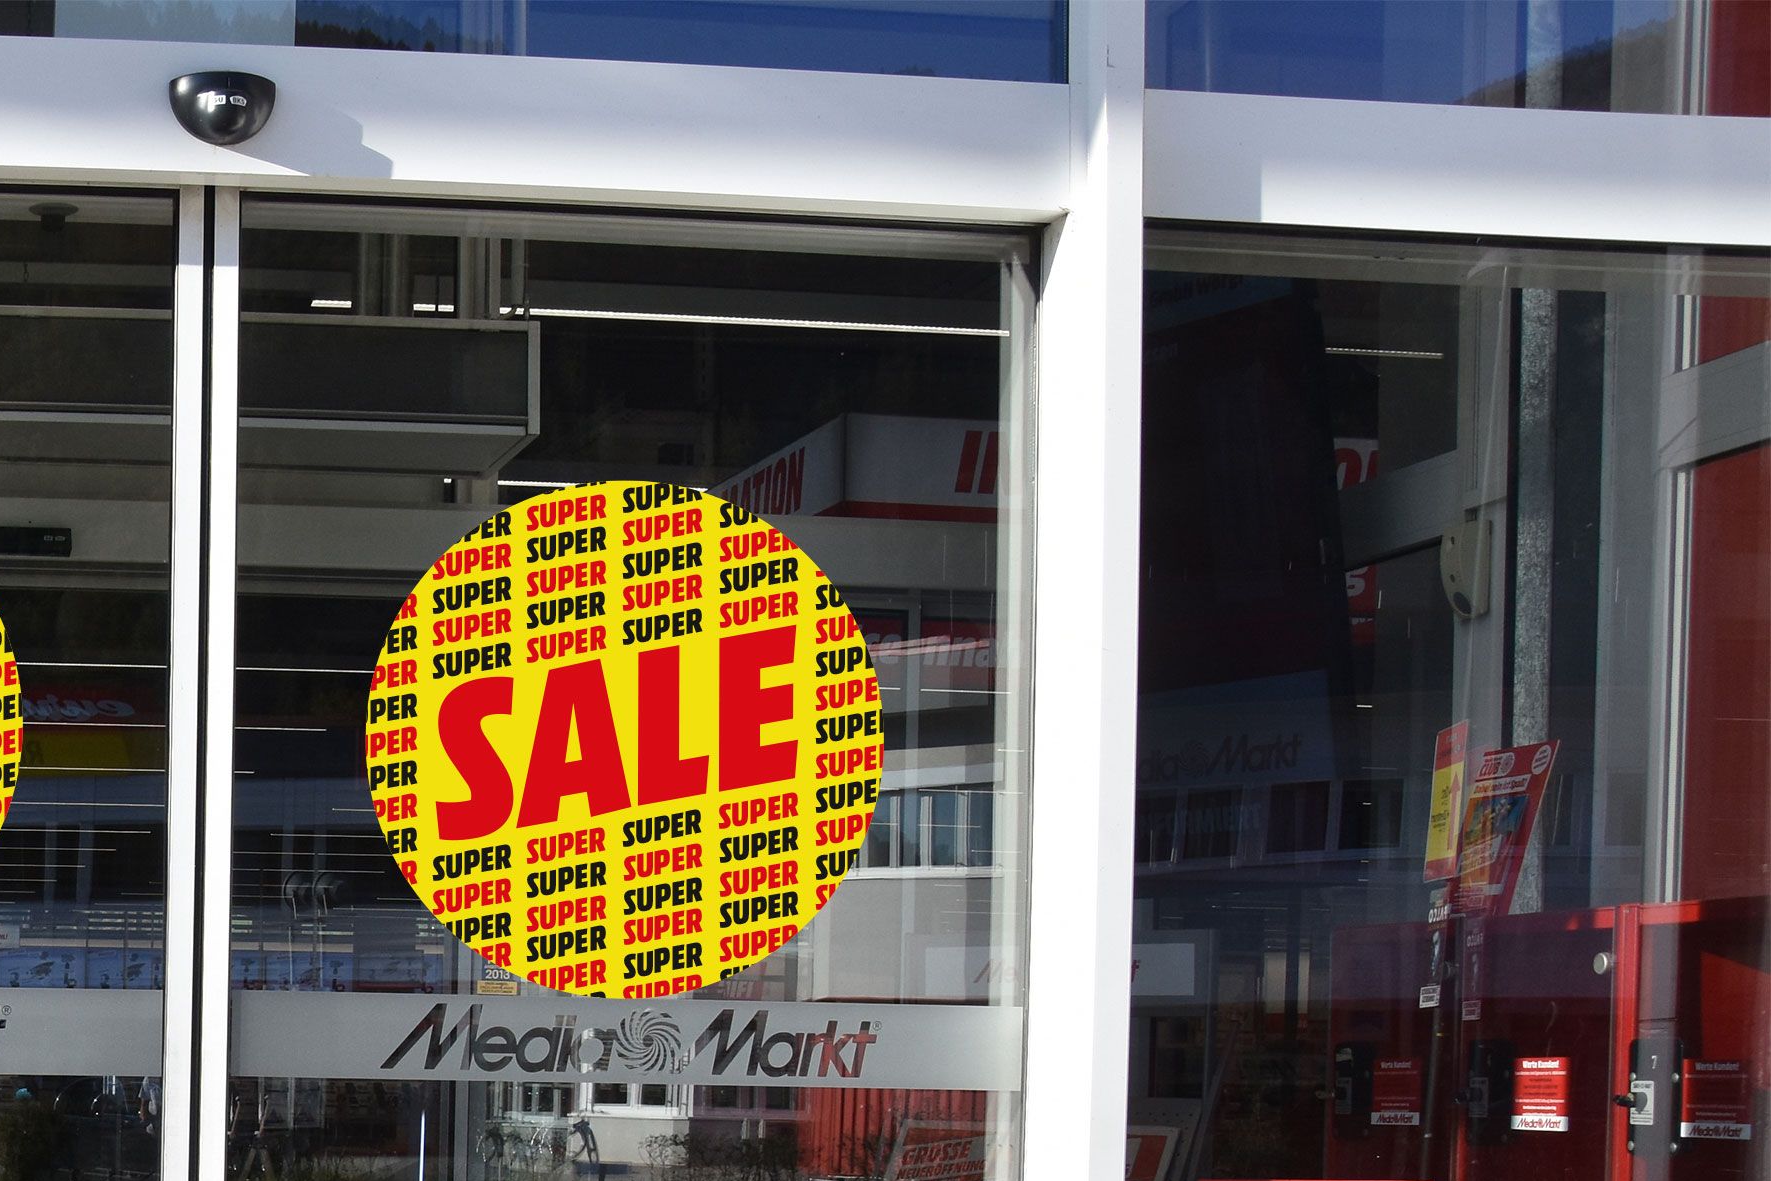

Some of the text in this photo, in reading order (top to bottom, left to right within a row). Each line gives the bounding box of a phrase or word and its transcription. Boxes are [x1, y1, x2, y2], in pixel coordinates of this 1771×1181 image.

[527, 527, 606, 563] SUPER
[623, 509, 702, 546] SUPER
[527, 561, 606, 596] SUPER
[623, 543, 702, 579] SUPER
[720, 558, 798, 594] SUPER
[433, 577, 511, 614] SUPER
[527, 592, 605, 629] SUPER
[623, 575, 702, 611] SUPER
[720, 592, 798, 628] SUPER
[433, 609, 511, 646] SUPER
[527, 626, 606, 662] SUPER
[433, 643, 511, 679] SUPER
[435, 625, 799, 841] SALE
[527, 828, 605, 864] SUPER
[623, 810, 701, 847] SUPER
[720, 827, 798, 863] SUPER
[433, 845, 511, 881] SUPER
[527, 862, 606, 898] SUPER
[624, 844, 702, 881] SUPER
[720, 861, 798, 897] SUPER
[433, 879, 511, 914] SUPER
[527, 896, 606, 932] SUPER
[624, 878, 702, 915] SUPER
[720, 892, 798, 928] SUPER
[527, 926, 606, 962] SUPER
[624, 909, 702, 945] SUPER
[485, 969, 510, 980] 2013
[624, 943, 702, 979] SUPER
[380, 1002, 878, 1078] Media Markt
[1651, 1056, 1658, 1069] 7
[902, 1140, 973, 1166] GROSSE
